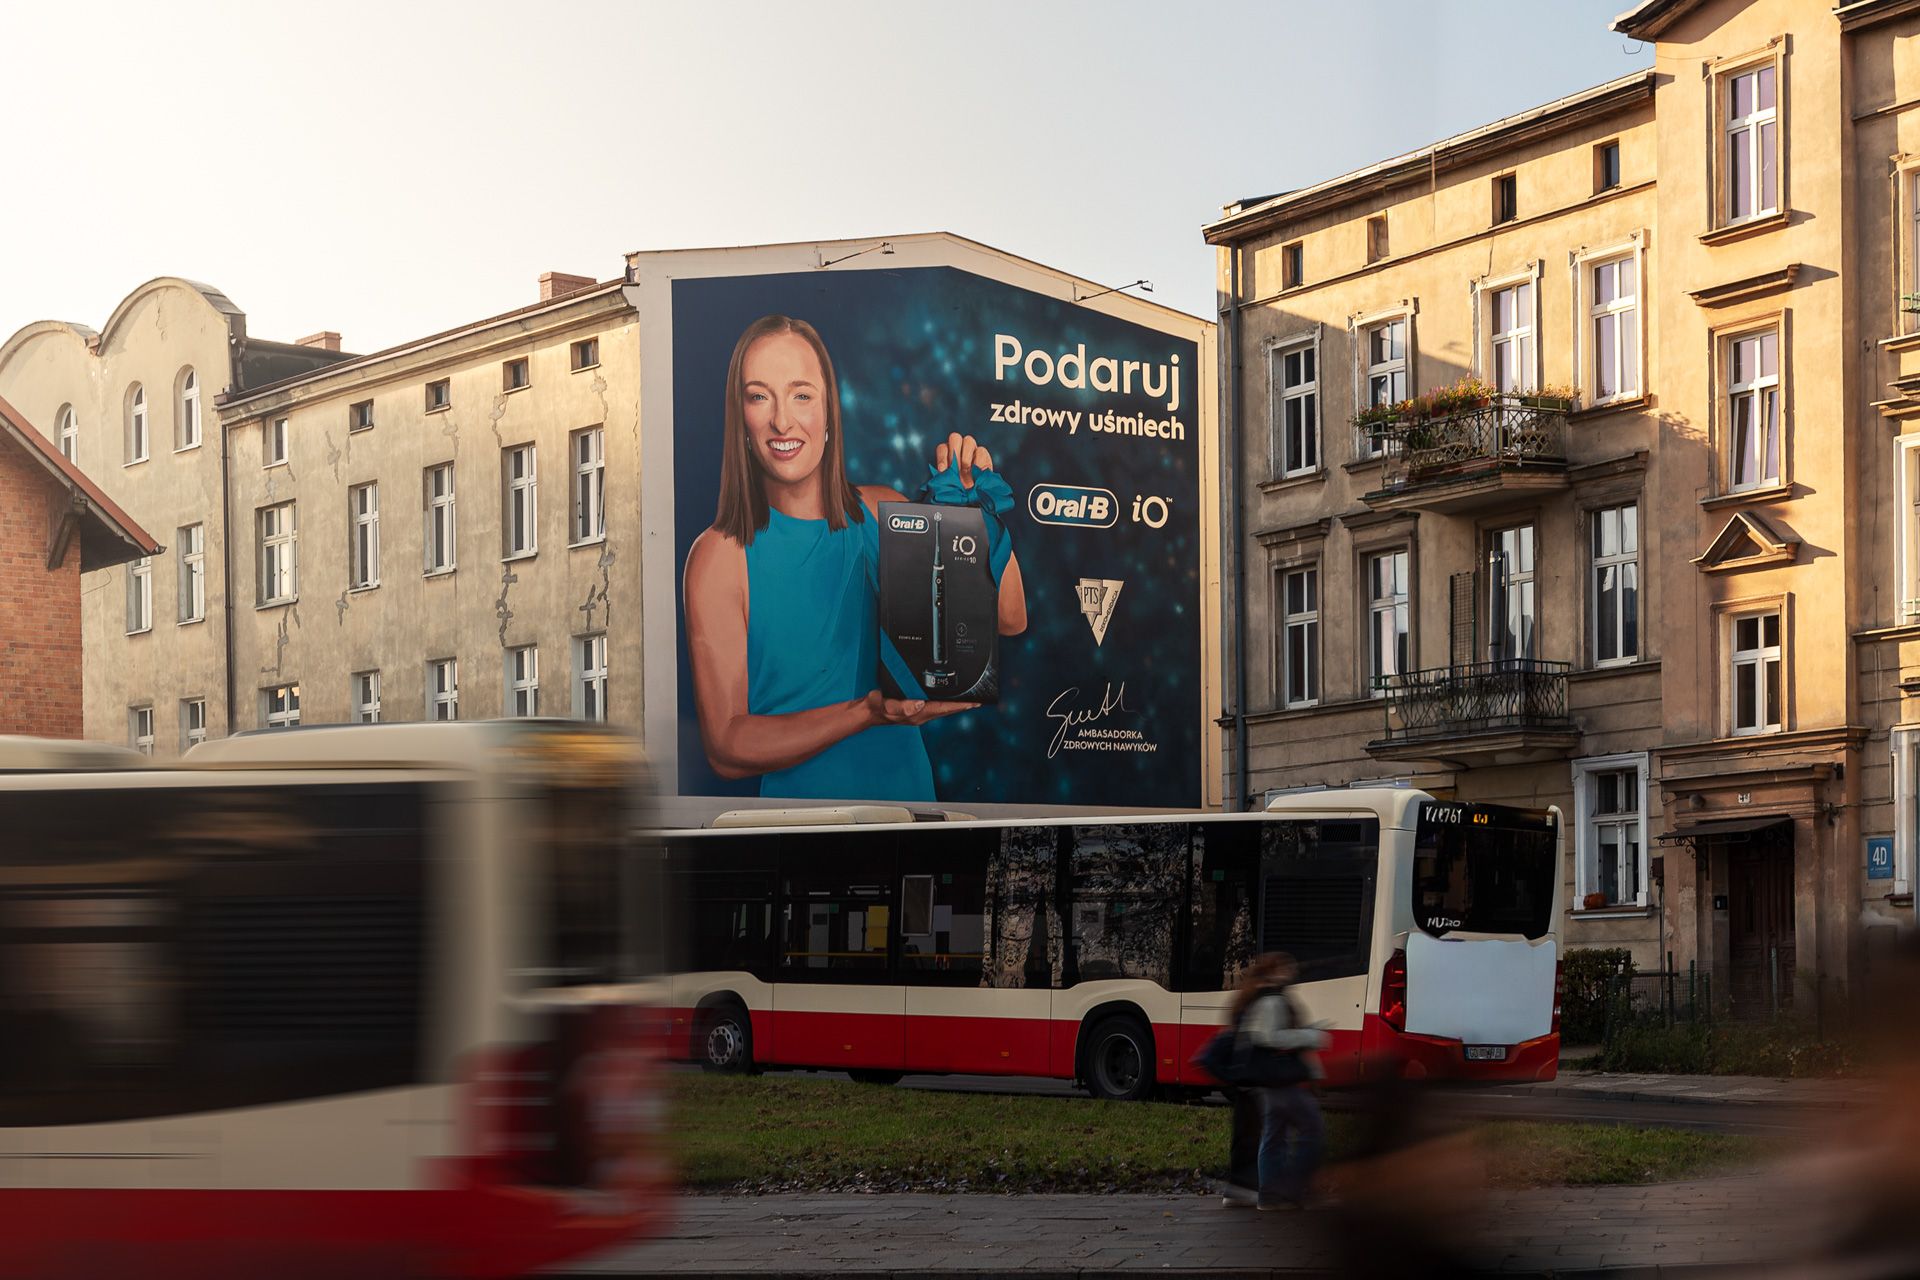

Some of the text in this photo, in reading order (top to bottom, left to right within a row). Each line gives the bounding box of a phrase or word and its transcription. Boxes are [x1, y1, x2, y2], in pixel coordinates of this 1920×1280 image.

[995, 333, 1180, 412] Podaruj
[990, 400, 1185, 441] zdrowy uśmiech
[1036, 491, 1109, 520] Oral-B
[891, 518, 925, 530] Oral-B
[952, 535, 976, 555] iO
[1084, 586, 1099, 605] PTS
[1078, 728, 1143, 740] AMBASADORKA
[1063, 740, 1158, 752] ZDROWYCH NAWYKÓW
[1872, 846, 1888, 866] 4D
